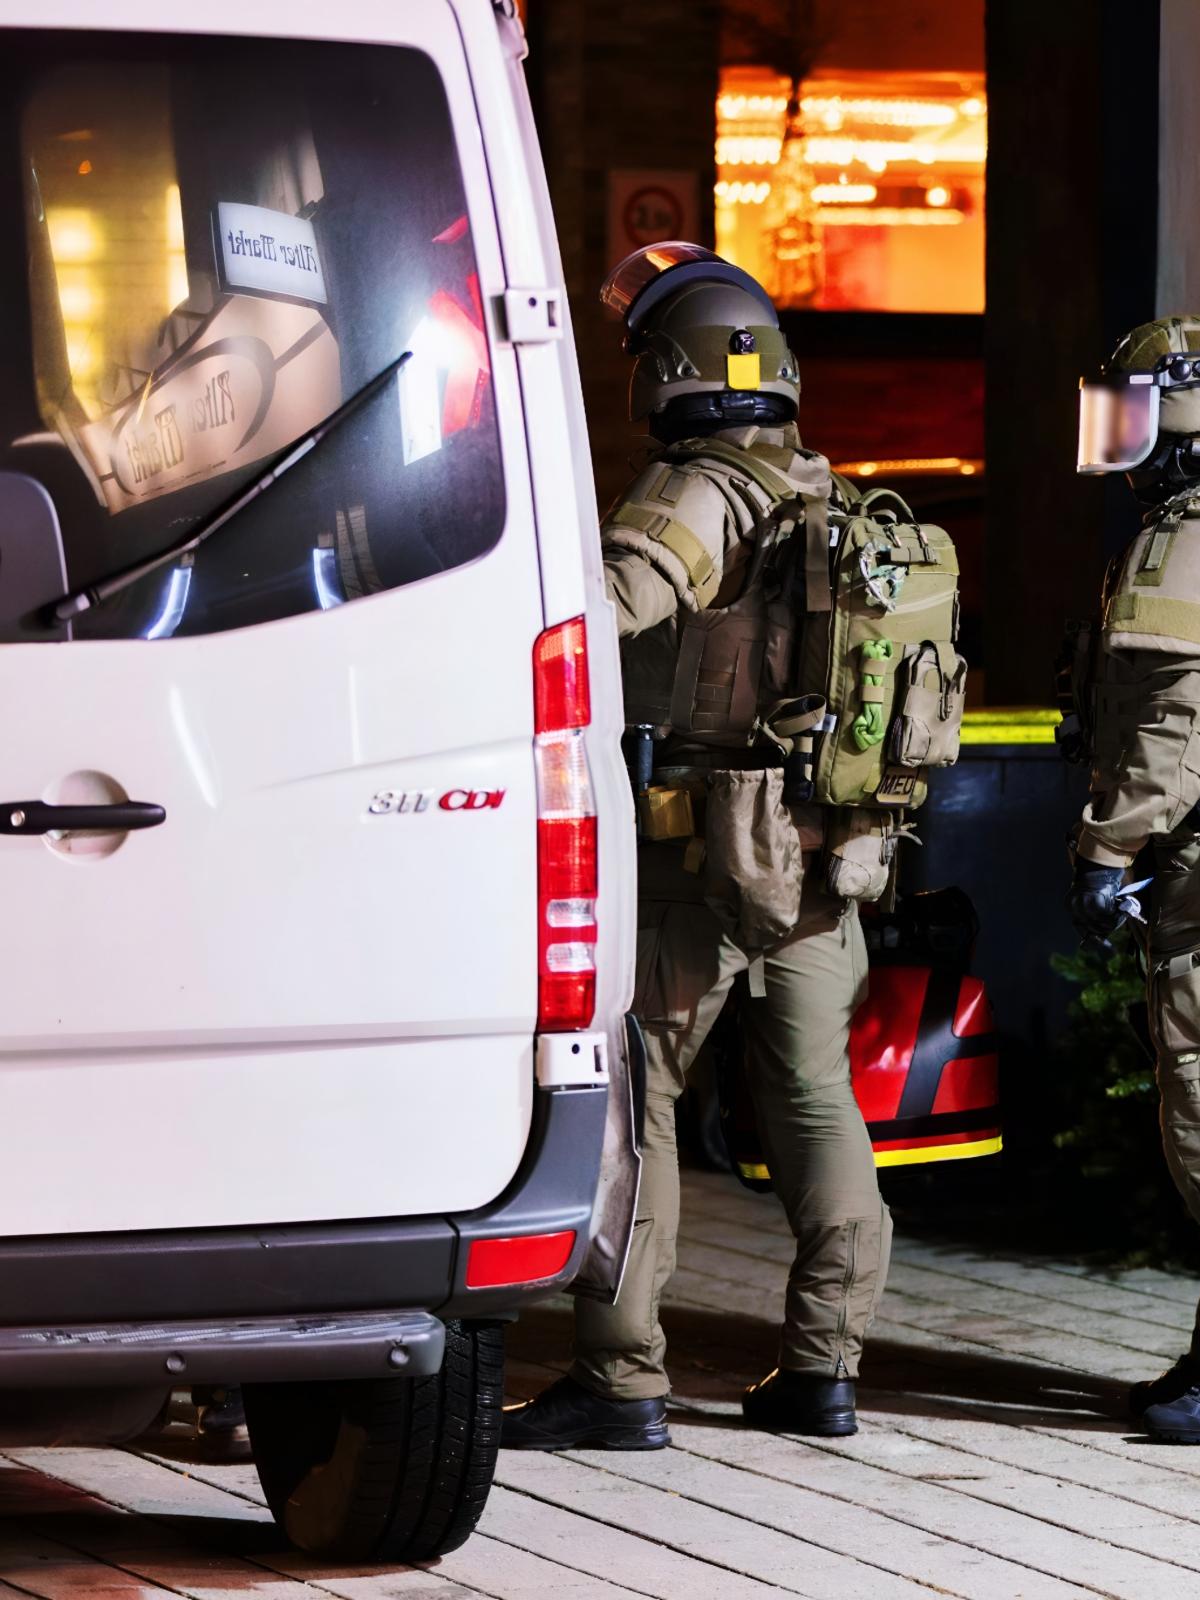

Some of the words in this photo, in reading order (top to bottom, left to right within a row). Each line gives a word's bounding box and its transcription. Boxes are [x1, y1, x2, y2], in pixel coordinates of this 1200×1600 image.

[879, 774, 915, 795] MED
[368, 790, 432, 814] 311
[438, 788, 507, 811] CDI
